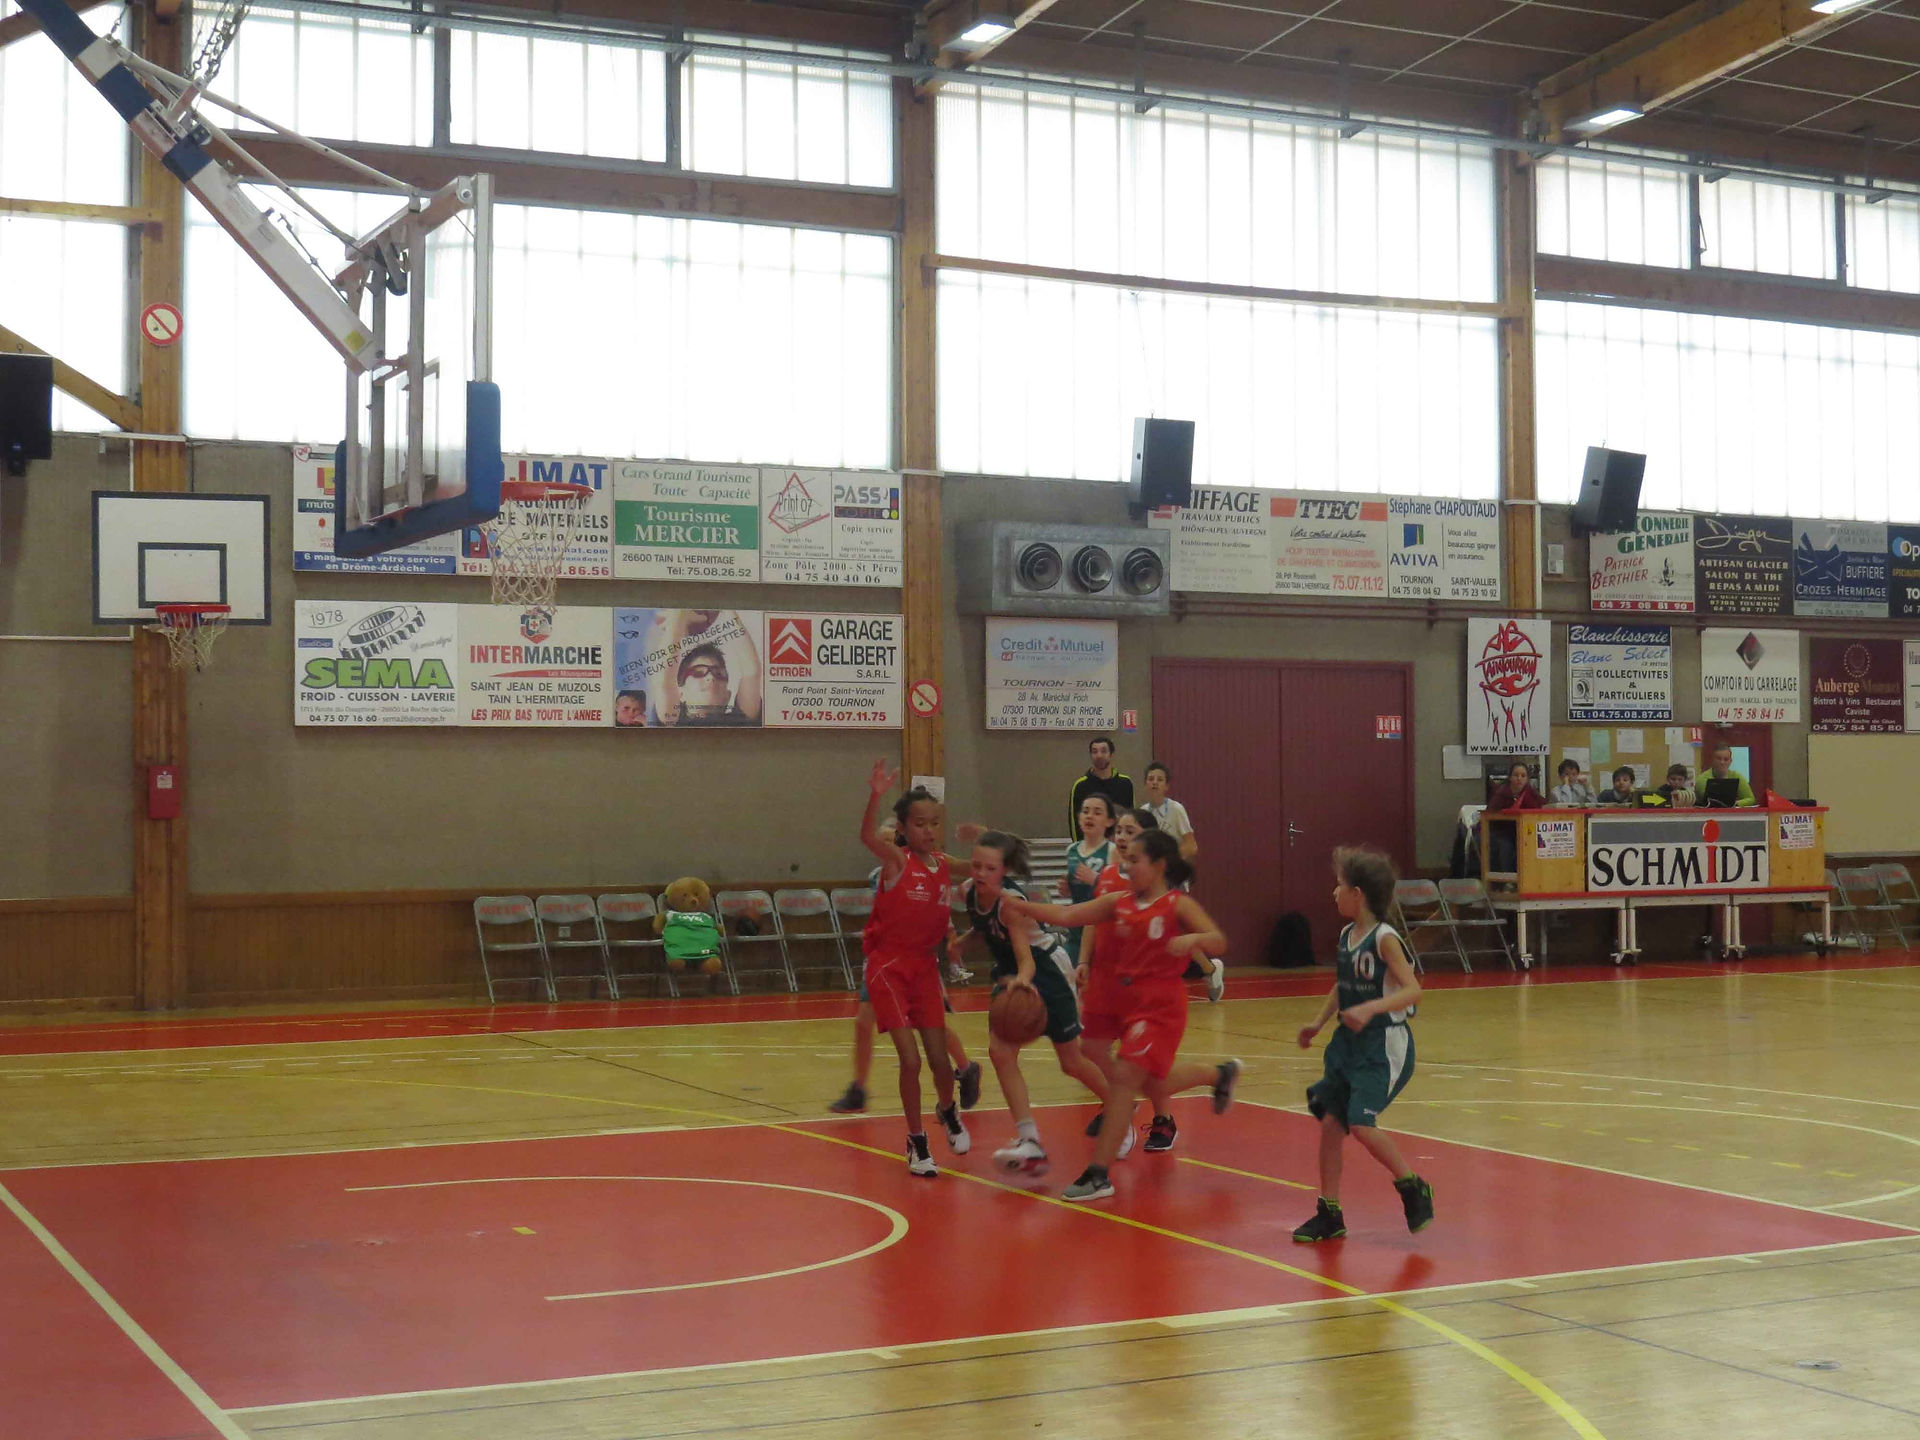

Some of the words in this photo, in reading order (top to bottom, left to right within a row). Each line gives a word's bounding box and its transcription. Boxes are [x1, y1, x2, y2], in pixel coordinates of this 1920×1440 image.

[622, 467, 649, 479] Cars
[653, 469, 692, 481] Grand
[697, 470, 752, 483] Tourisme
[653, 483, 688, 496] Toute
[699, 486, 751, 501] Capacité
[1190, 489, 1260, 512] IFFAGE
[1300, 499, 1359, 520] TTEC
[1390, 498, 1431, 518] Stéphane
[1434, 500, 1496, 518] CHAPOUTAUD
[644, 506, 731, 523] Tourisme
[1181, 512, 1221, 522] TRAVAUX
[1225, 514, 1260, 523] PUBLICS
[634, 524, 740, 545] MERCIER
[842, 524, 862, 533] Copie
[622, 554, 651, 562] 26600
[654, 555, 673, 563] TAIN
[1390, 553, 1438, 567] AVIVA
[1699, 559, 1743, 568] ARTISAN
[1747, 561, 1788, 569] GLACIER
[342, 563, 426, 572] Drôme-Ardèche
[688, 567, 751, 576] 75.08.26.52
[764, 560, 788, 570] Zone
[795, 560, 816, 571] Pôle
[823, 562, 846, 571] 2000
[856, 562, 866, 572] St
[872, 563, 898, 574] Péray
[1846, 566, 1884, 579] BUFFIERE
[785, 573, 799, 581] 04
[806, 574, 818, 582] 75
[823, 574, 839, 582] 40
[865, 575, 880, 583] 06
[1400, 576, 1433, 584] TOURNON
[1592, 568, 1648, 590] BERTHIER
[1705, 571, 1738, 579] SALON
[1333, 575, 1383, 591] 75.07.11.12
[1451, 578, 1497, 586] SAINT-VALLIER
[1709, 582, 1741, 590] REPAS
[1451, 588, 1459, 596] 04
[1796, 584, 1831, 595] CROZES
[1838, 585, 1886, 597] HERMITAGE
[1904, 605, 1912, 613] 04
[310, 610, 343, 625] 1978
[820, 619, 893, 640] GARAGE
[1570, 625, 1668, 643] Blanchisserie
[1060, 639, 1104, 652] Mutuel
[619, 658, 643, 675] BIEN
[645, 649, 667, 664] VOIR
[669, 642, 681, 654] EN
[667, 655, 679, 667] ET
[817, 645, 896, 666] GELIBERT
[1571, 651, 1612, 664] Blanc
[1623, 647, 1667, 660] Select
[301, 658, 454, 689] SEMA
[857, 670, 891, 678] S.A.R.L.
[1596, 670, 1668, 679] COLLECTIVITES
[471, 682, 500, 691] SAINT
[507, 682, 530, 691] JEAN
[539, 683, 553, 691] DE
[558, 683, 601, 692] MUZOLS
[1003, 679, 1064, 687] TOURNON
[1704, 676, 1742, 691] COMPTOIR
[1744, 676, 1754, 691] DU
[1757, 677, 1797, 691] CARRELAGE
[1815, 678, 1859, 695] Auberge
[301, 692, 336, 701] FROID
[348, 693, 399, 701] CUISSON
[412, 693, 455, 701] LAVERIE
[488, 695, 511, 703] TAIN
[516, 695, 585, 704] L'HERMITAGE
[1600, 691, 1666, 700] PARTICULIERS
[1814, 697, 1836, 705] Bistrot
[1845, 697, 1860, 705] Vins
[792, 697, 823, 706] 07300
[828, 698, 875, 707] TOURNON
[472, 709, 487, 721] LES
[491, 709, 511, 721] PRIX
[516, 709, 532, 721] BAS
[536, 709, 563, 721] TOUTE
[567, 709, 602, 721] L'ANNEE
[1003, 706, 1023, 714] 07300
[1028, 706, 1059, 714] TOURNON
[1063, 706, 1076, 715] SUR
[1593, 711, 1670, 719] 04.75.08.87.48
[1717, 707, 1729, 719] 04
[1733, 707, 1742, 719] 75
[1746, 707, 1756, 720] 58
[1760, 708, 1771, 720] 84
[1774, 708, 1784, 720] 15
[1471, 745, 1547, 753] www.agttbc.fr
[1352, 950, 1374, 980] 10
